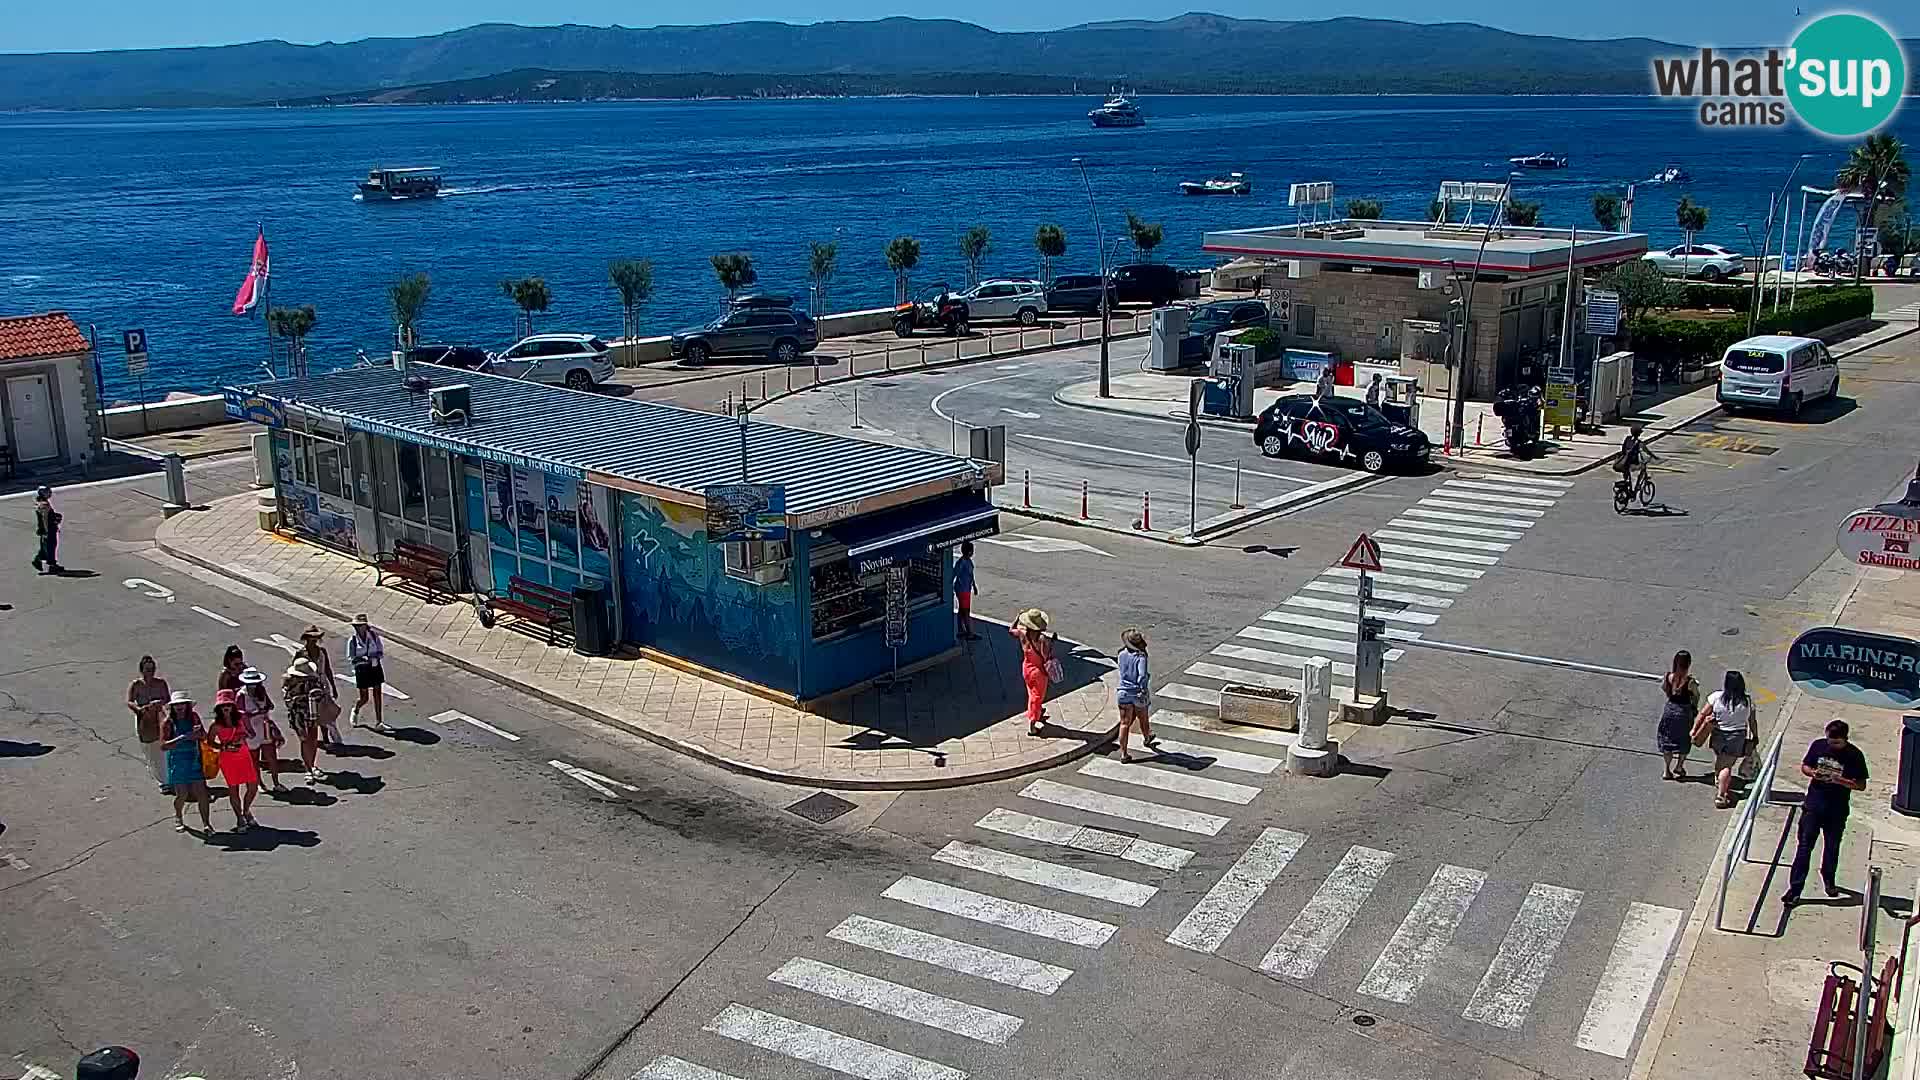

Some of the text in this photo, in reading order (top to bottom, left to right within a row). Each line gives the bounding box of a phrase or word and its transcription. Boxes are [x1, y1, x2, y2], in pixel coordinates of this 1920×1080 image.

[128, 332, 141, 351] P
[435, 440, 467, 453] POSTAJA
[477, 447, 492, 459] BUS
[493, 450, 525, 467] STATION
[528, 458, 553, 473] TICKET
[554, 464, 581, 478] OFFICE
[1828, 663, 1896, 681] caffe bar
